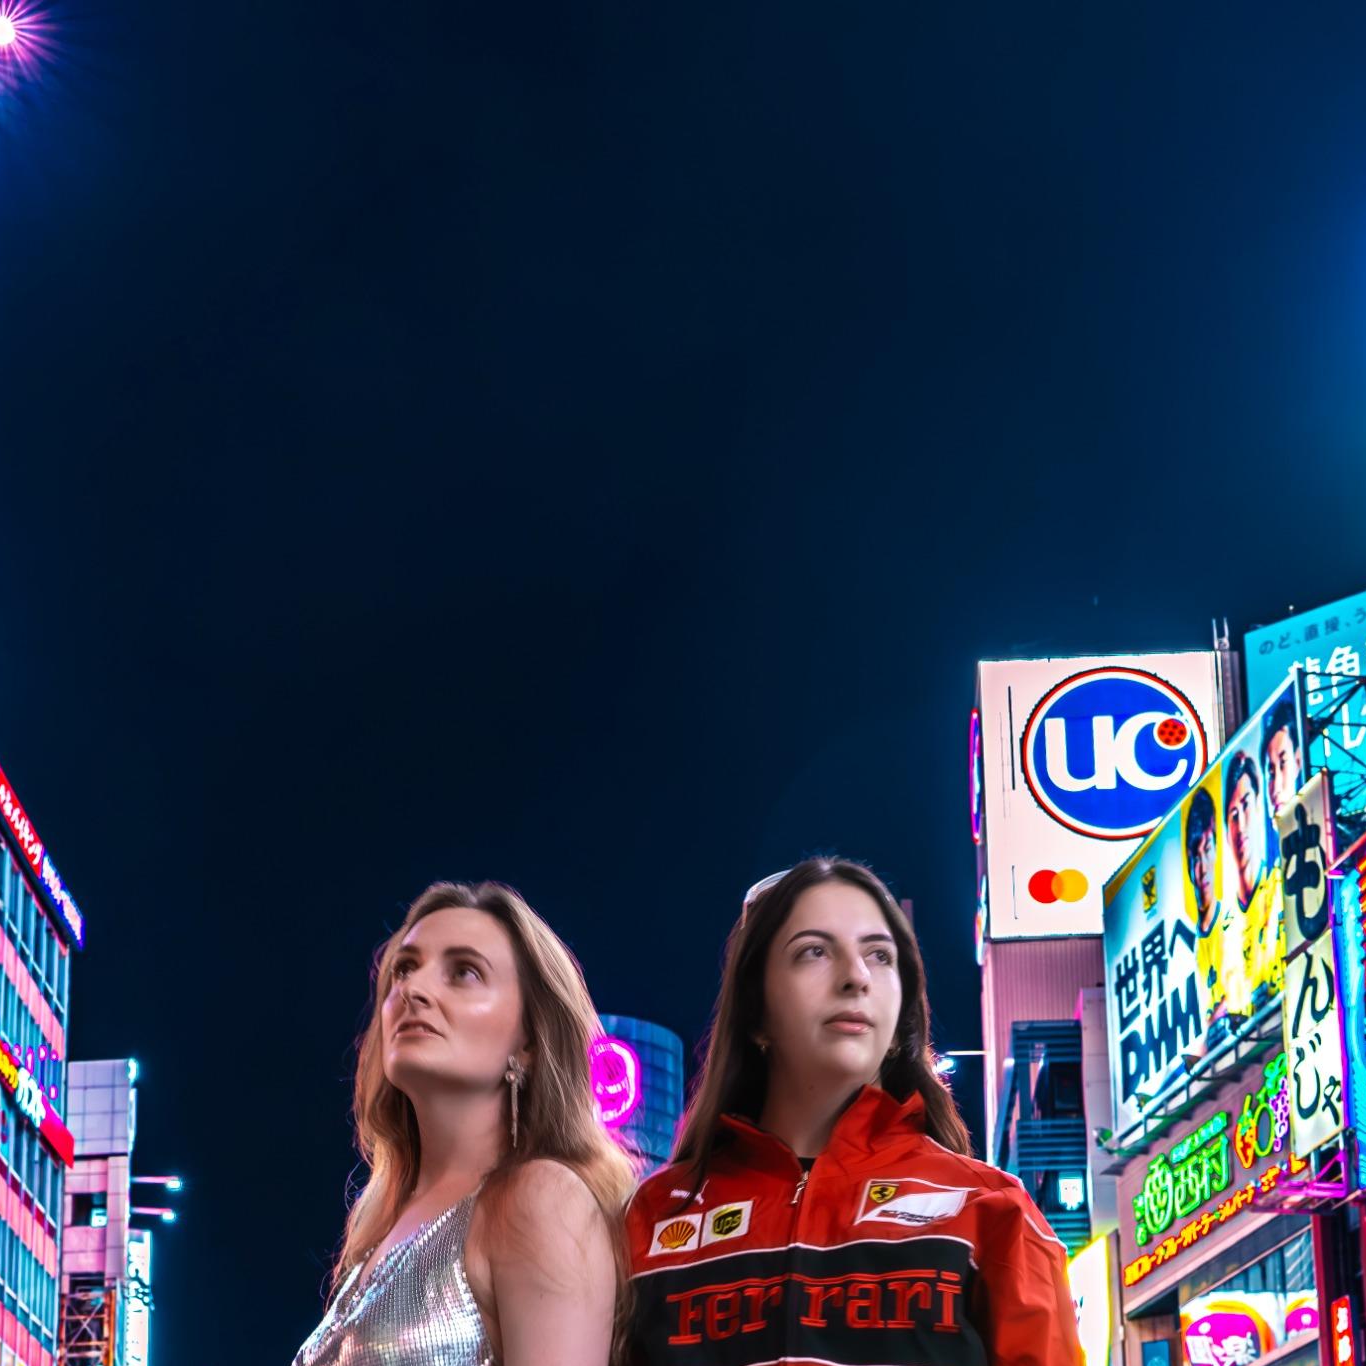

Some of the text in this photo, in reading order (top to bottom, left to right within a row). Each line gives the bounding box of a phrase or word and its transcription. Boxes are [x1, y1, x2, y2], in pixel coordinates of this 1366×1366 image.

[1114, 917, 1199, 1037] 世界へ
[1282, 802, 1343, 1124] もんじゃ
[1119, 986, 1204, 1107] DMM
[666, 1268, 963, 1346] Ferrari
